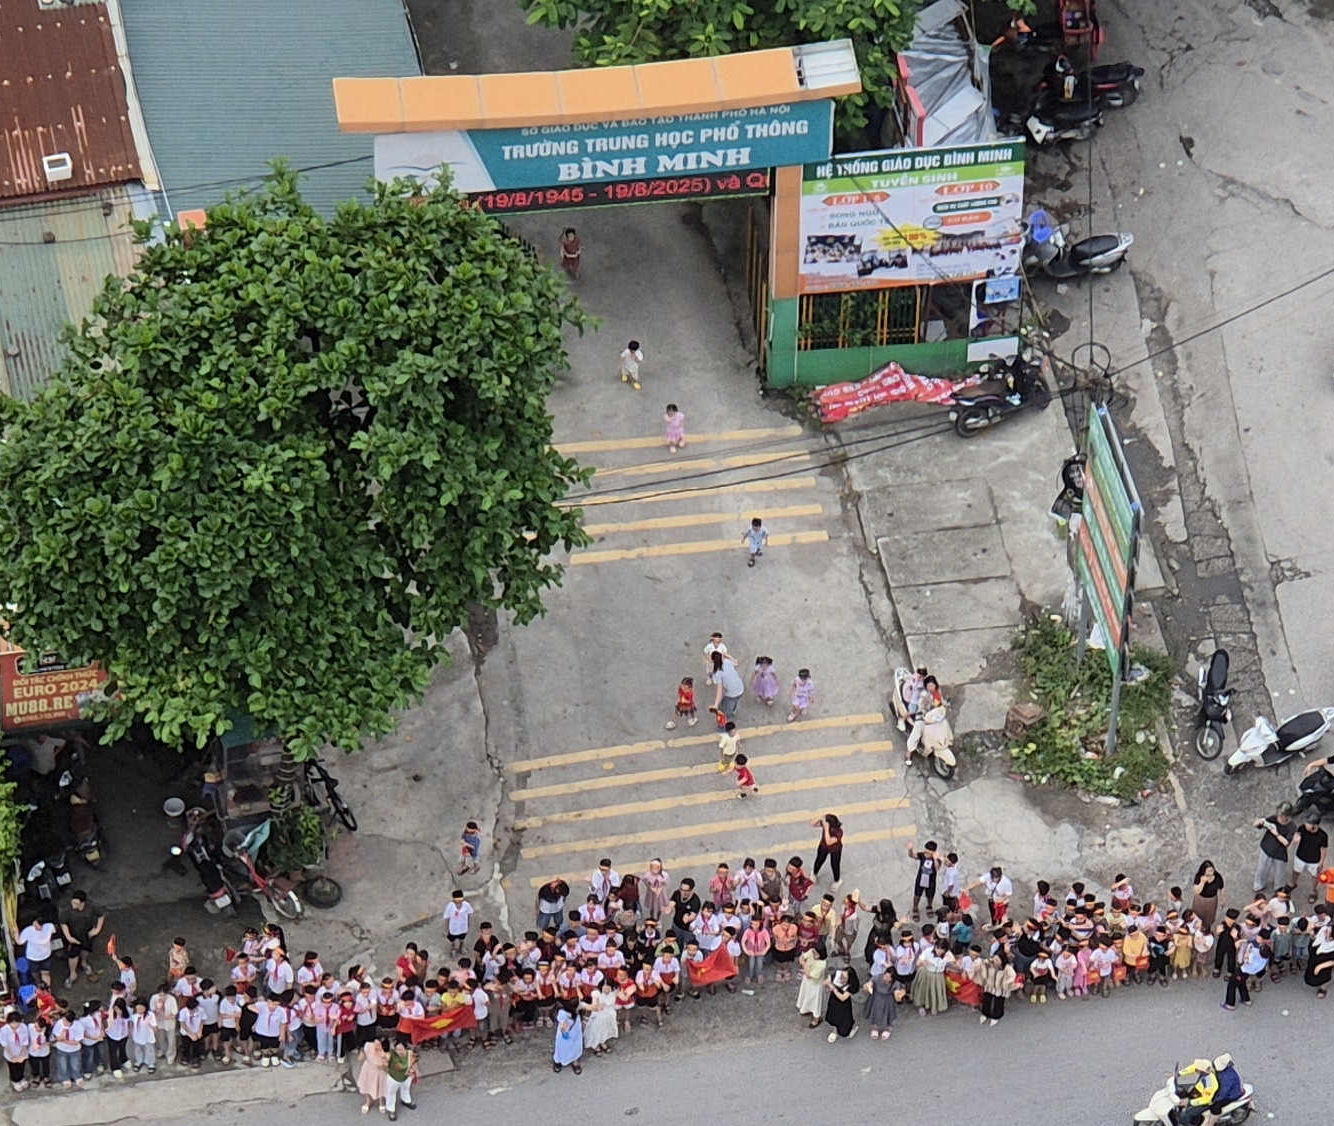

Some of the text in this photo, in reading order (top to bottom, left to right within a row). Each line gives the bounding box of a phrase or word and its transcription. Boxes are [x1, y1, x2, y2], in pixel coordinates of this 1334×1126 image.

[769, 103, 791, 115] NỘI
[501, 119, 809, 160] TRƯỜNG TRUNG HỌC PHỔ THÔNG
[557, 147, 752, 182] BÌNH MINH
[816, 148, 1012, 179] HỆ THỐNG GIÁO DỤC BÌNH MINH
[921, 171, 958, 185] SINH
[13, 679, 98, 699] EURO 2024
